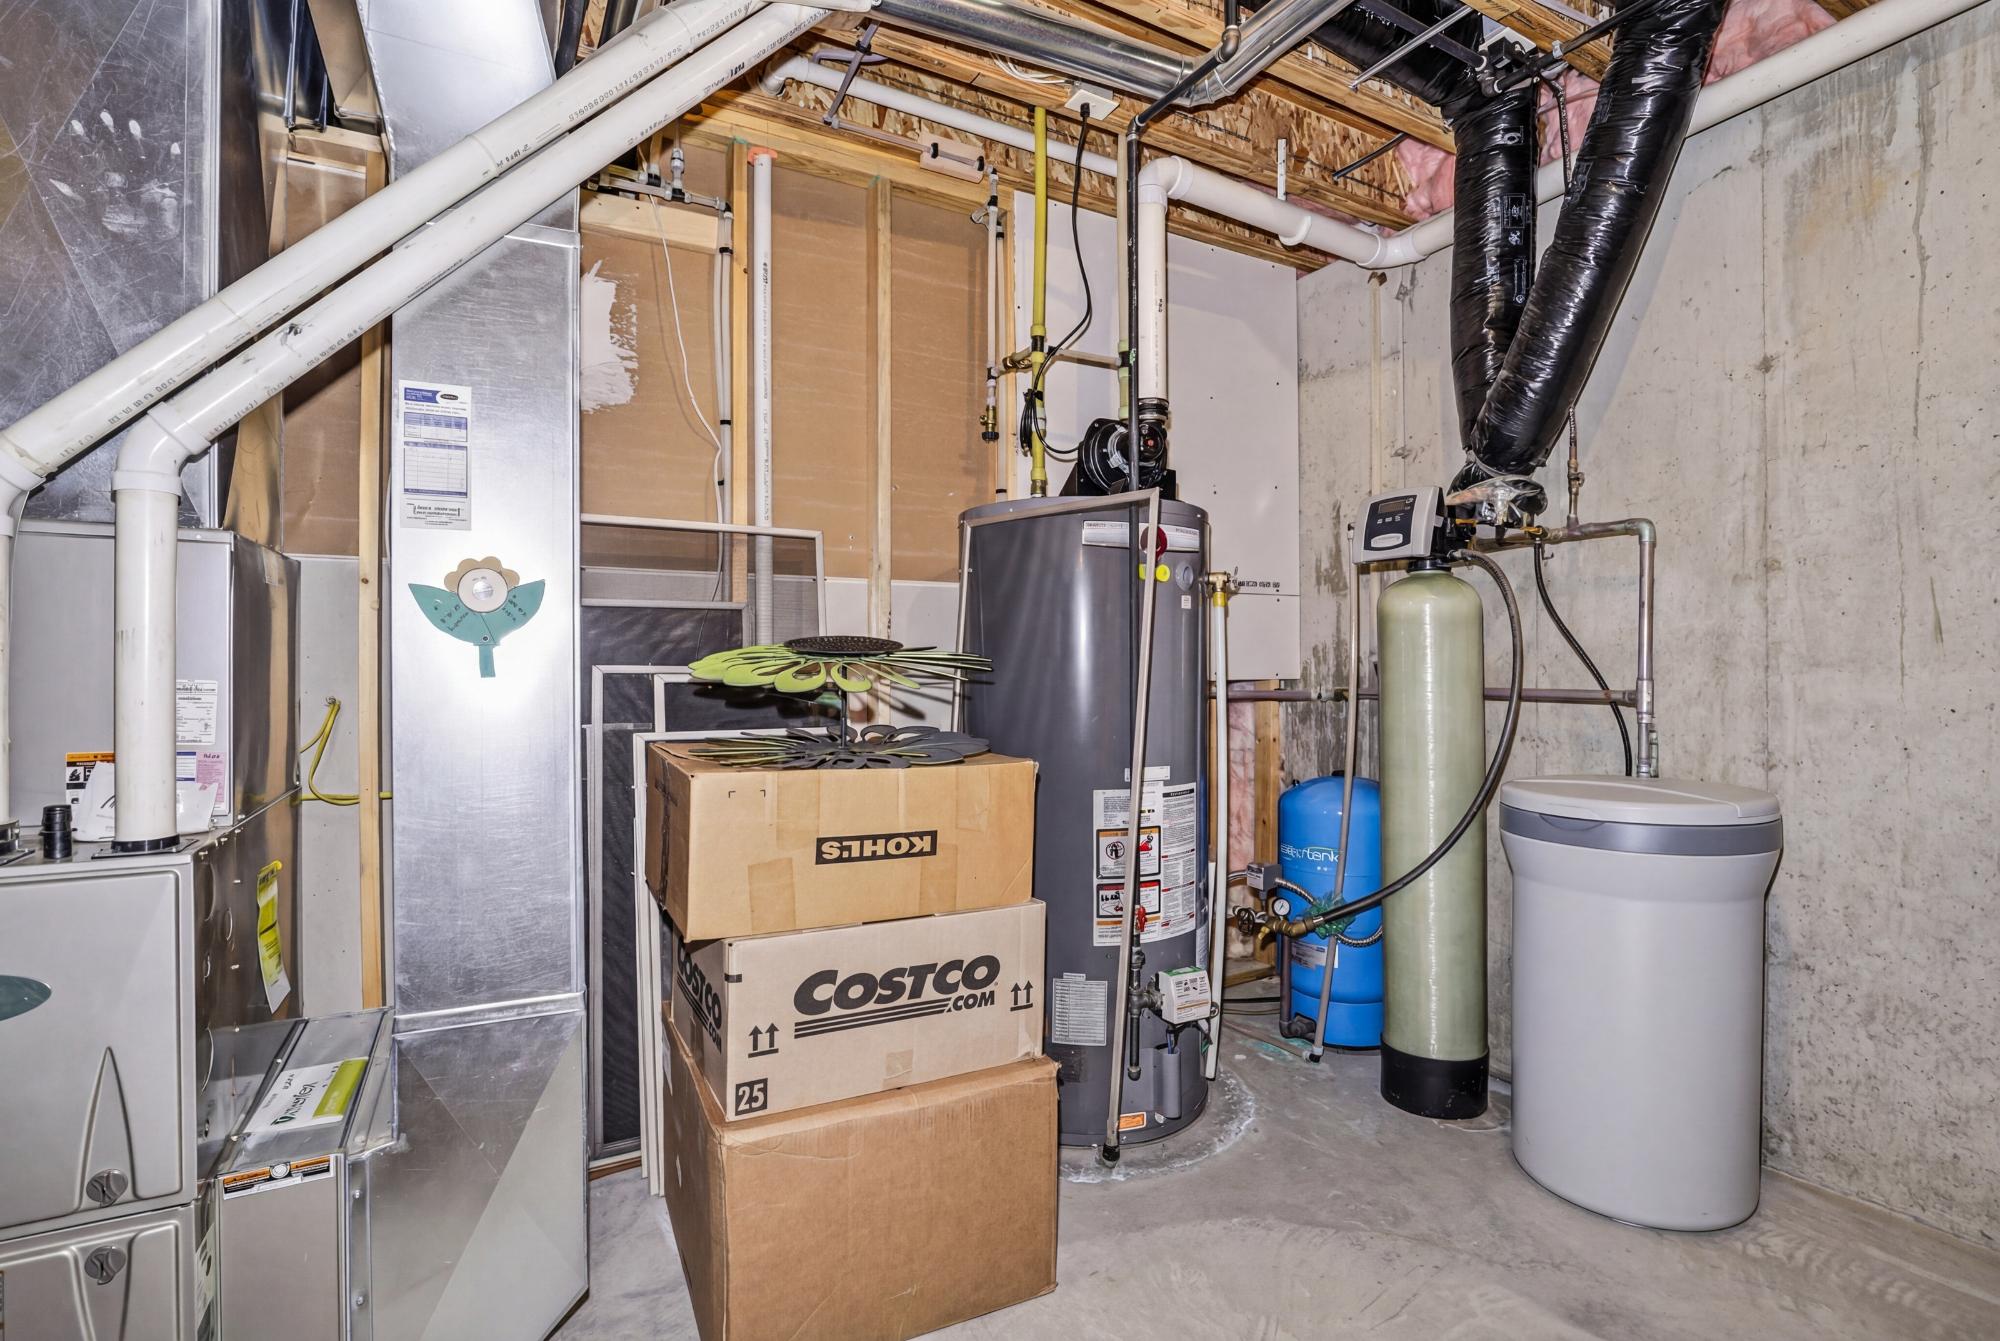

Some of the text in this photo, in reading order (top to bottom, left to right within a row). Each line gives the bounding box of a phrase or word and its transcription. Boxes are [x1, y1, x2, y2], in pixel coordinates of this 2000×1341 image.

[820, 835, 932, 860] KOHL'S
[793, 955, 1000, 1016] COSTCO
[737, 1083, 765, 1110] 25
